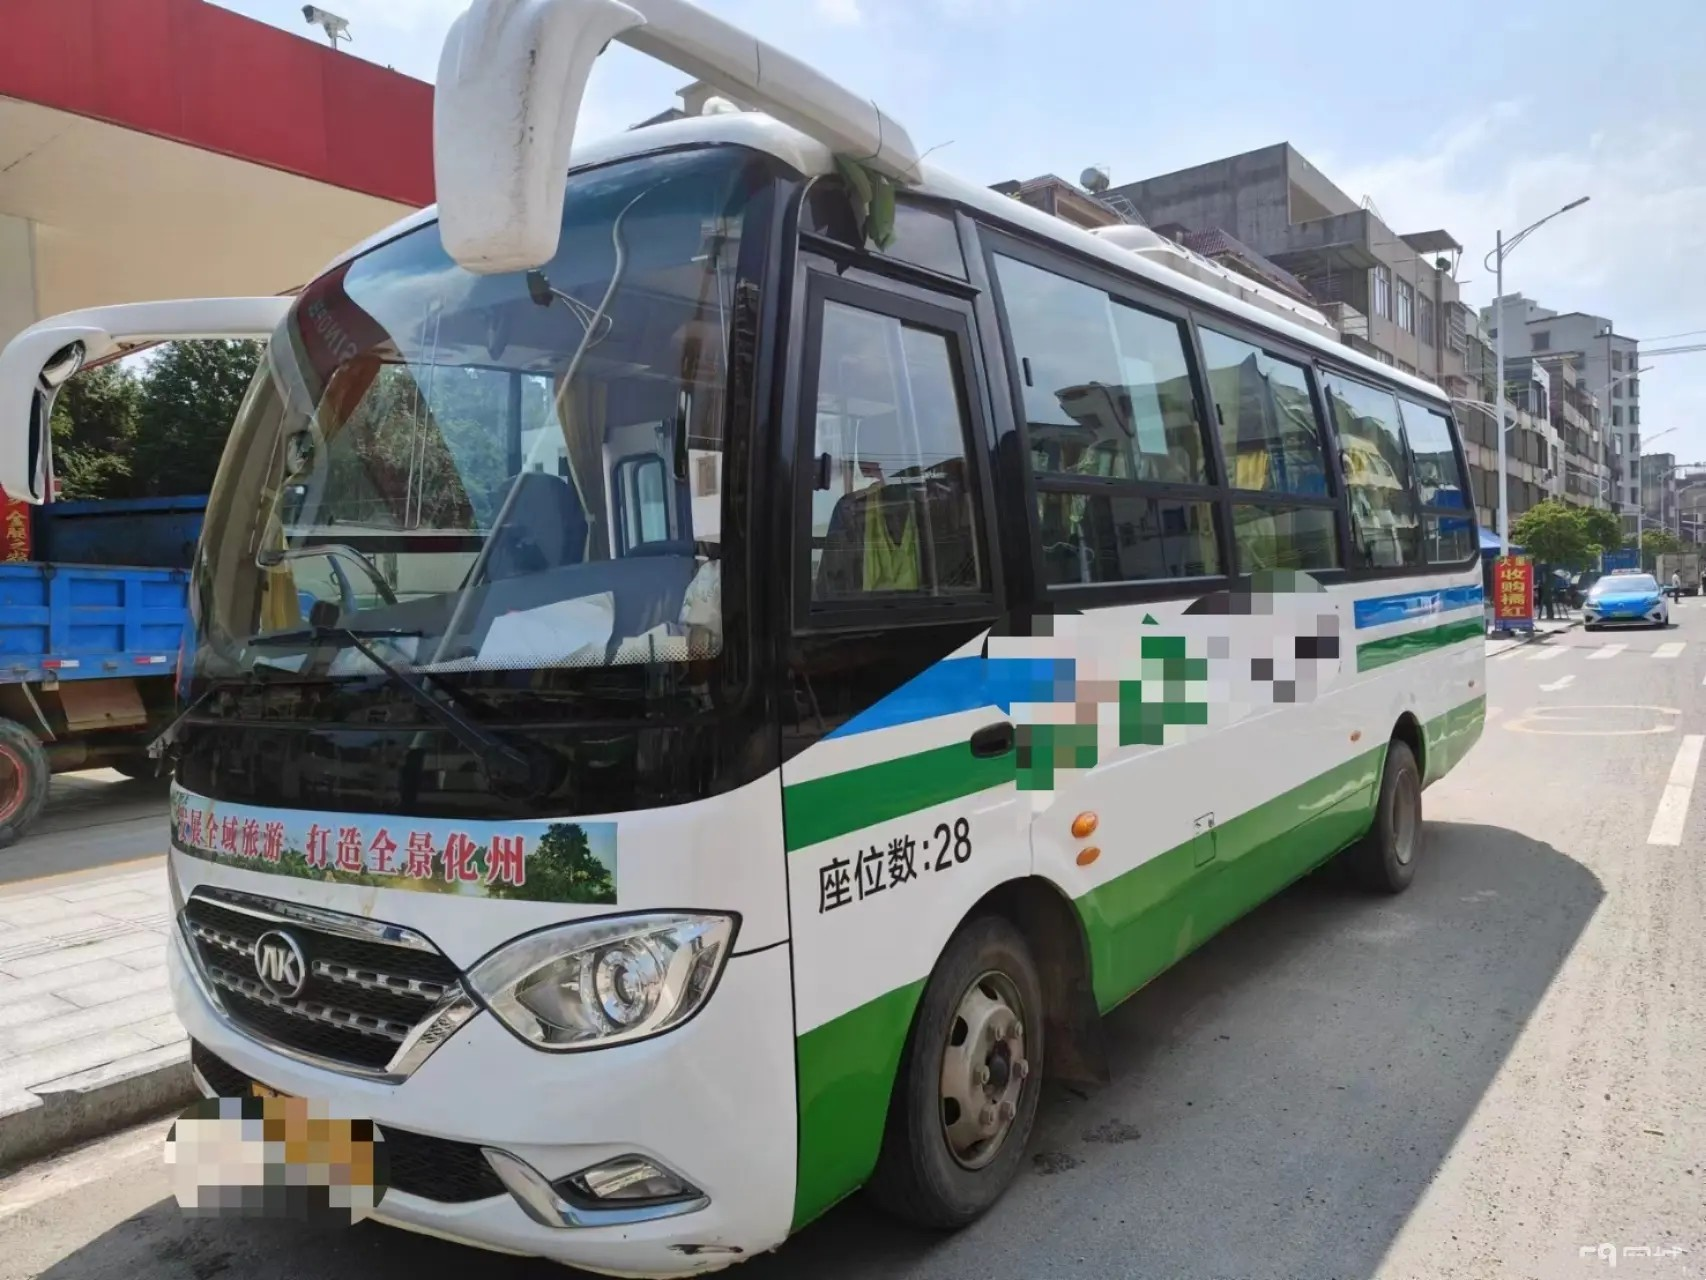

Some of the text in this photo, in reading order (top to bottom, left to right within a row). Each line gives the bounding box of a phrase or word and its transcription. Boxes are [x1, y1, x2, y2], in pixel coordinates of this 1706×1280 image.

[304, 822, 527, 886] 打造全景化州
